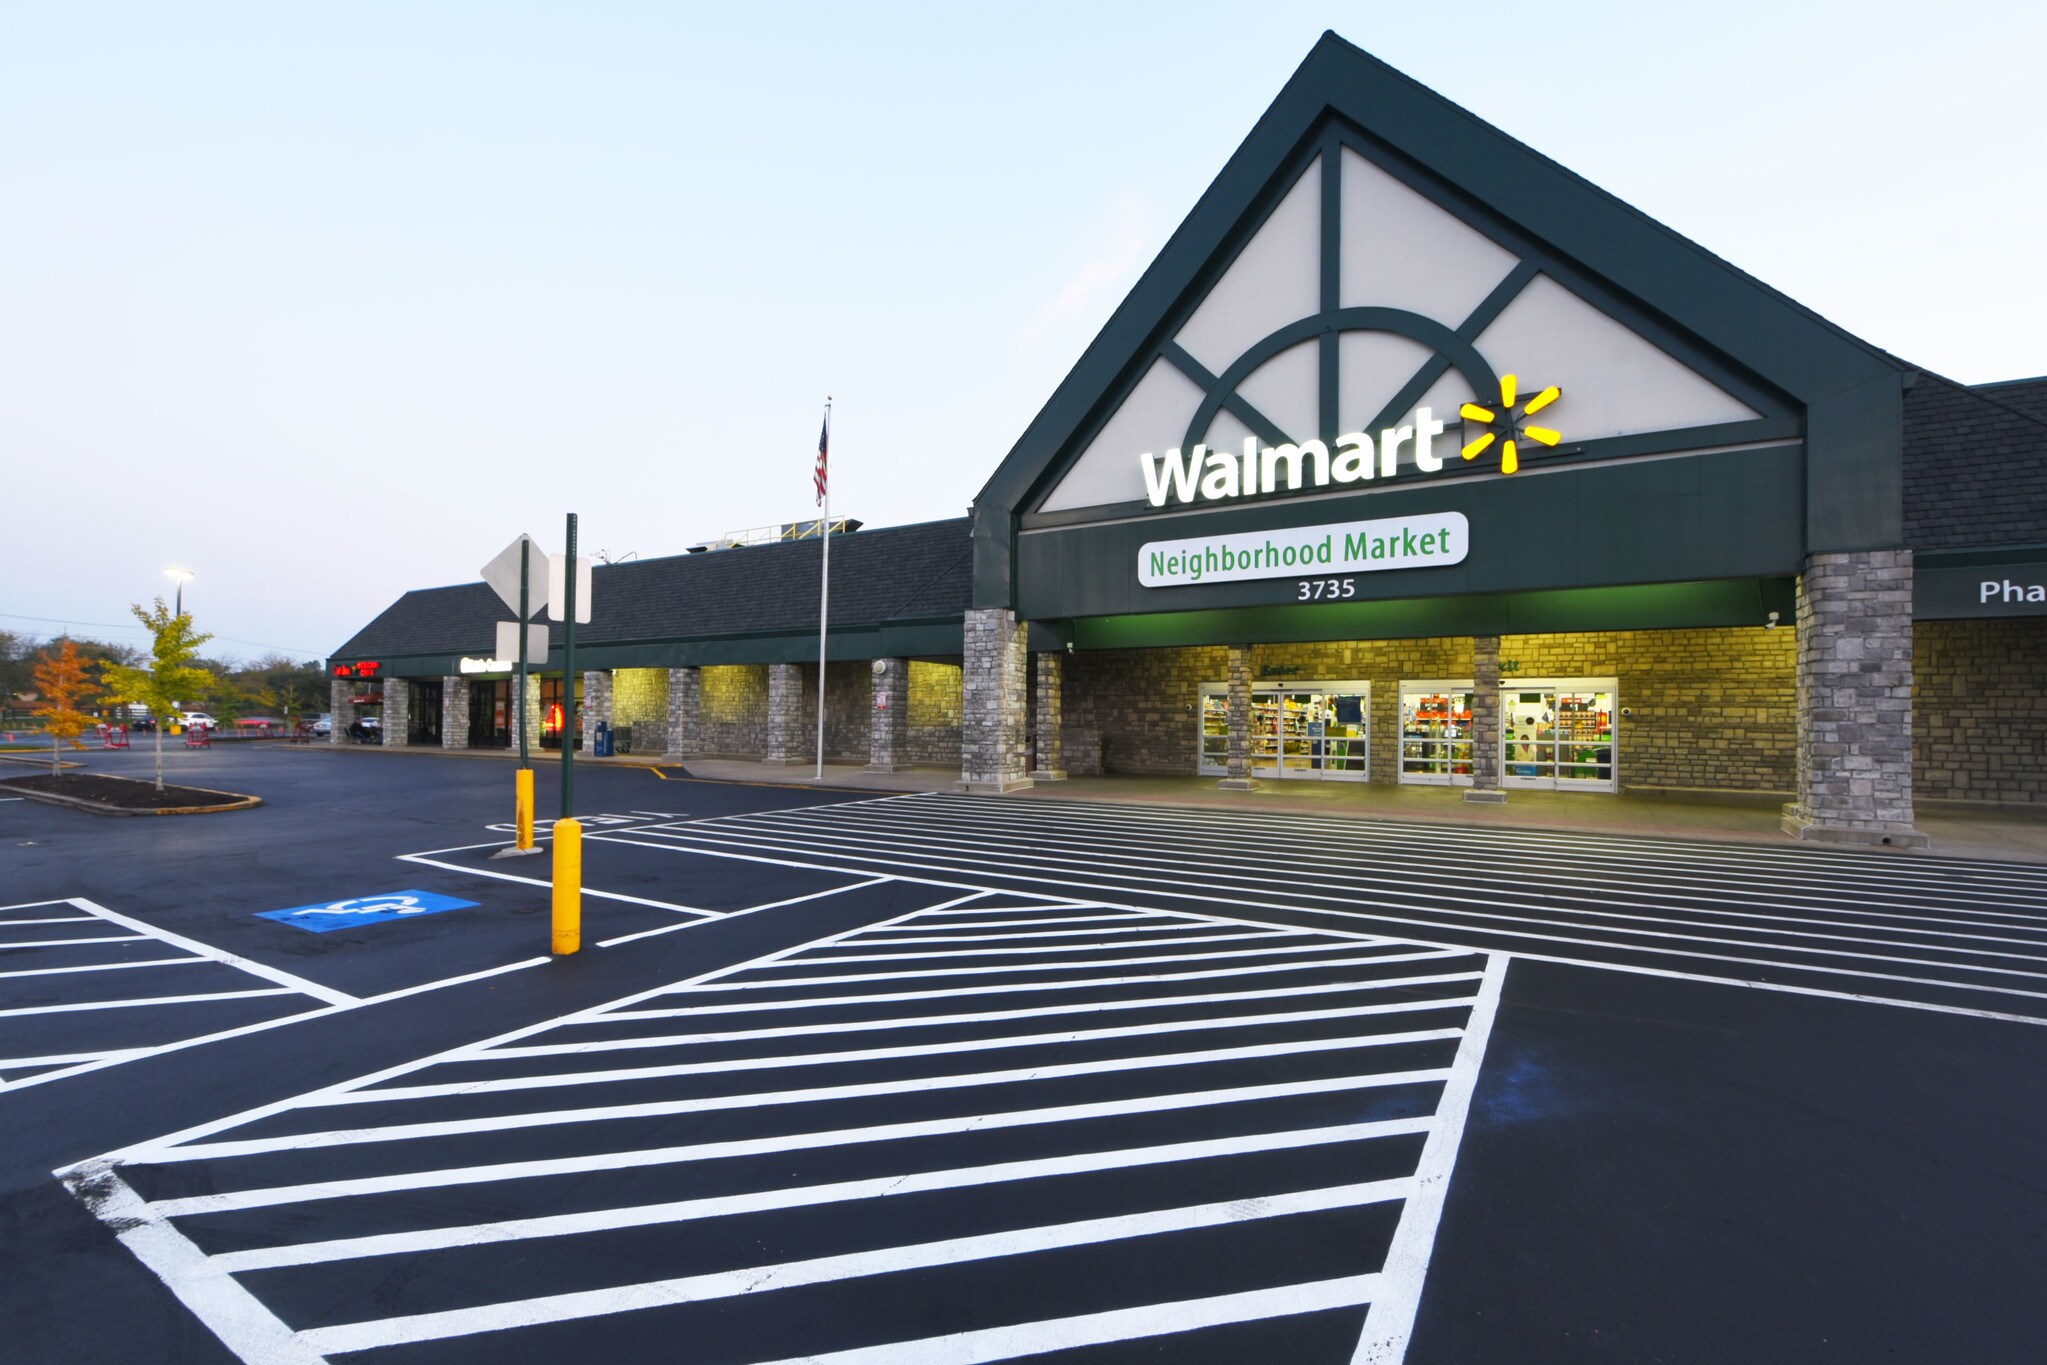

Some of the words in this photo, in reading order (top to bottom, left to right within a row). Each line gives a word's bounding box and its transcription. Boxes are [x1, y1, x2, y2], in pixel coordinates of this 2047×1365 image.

[1140, 406, 1445, 508] Walmart
[1150, 535, 1333, 581] Neighborhood
[1343, 527, 1451, 562] Market
[1297, 578, 1356, 601] 3735
[1980, 579, 2046, 604] Pha
